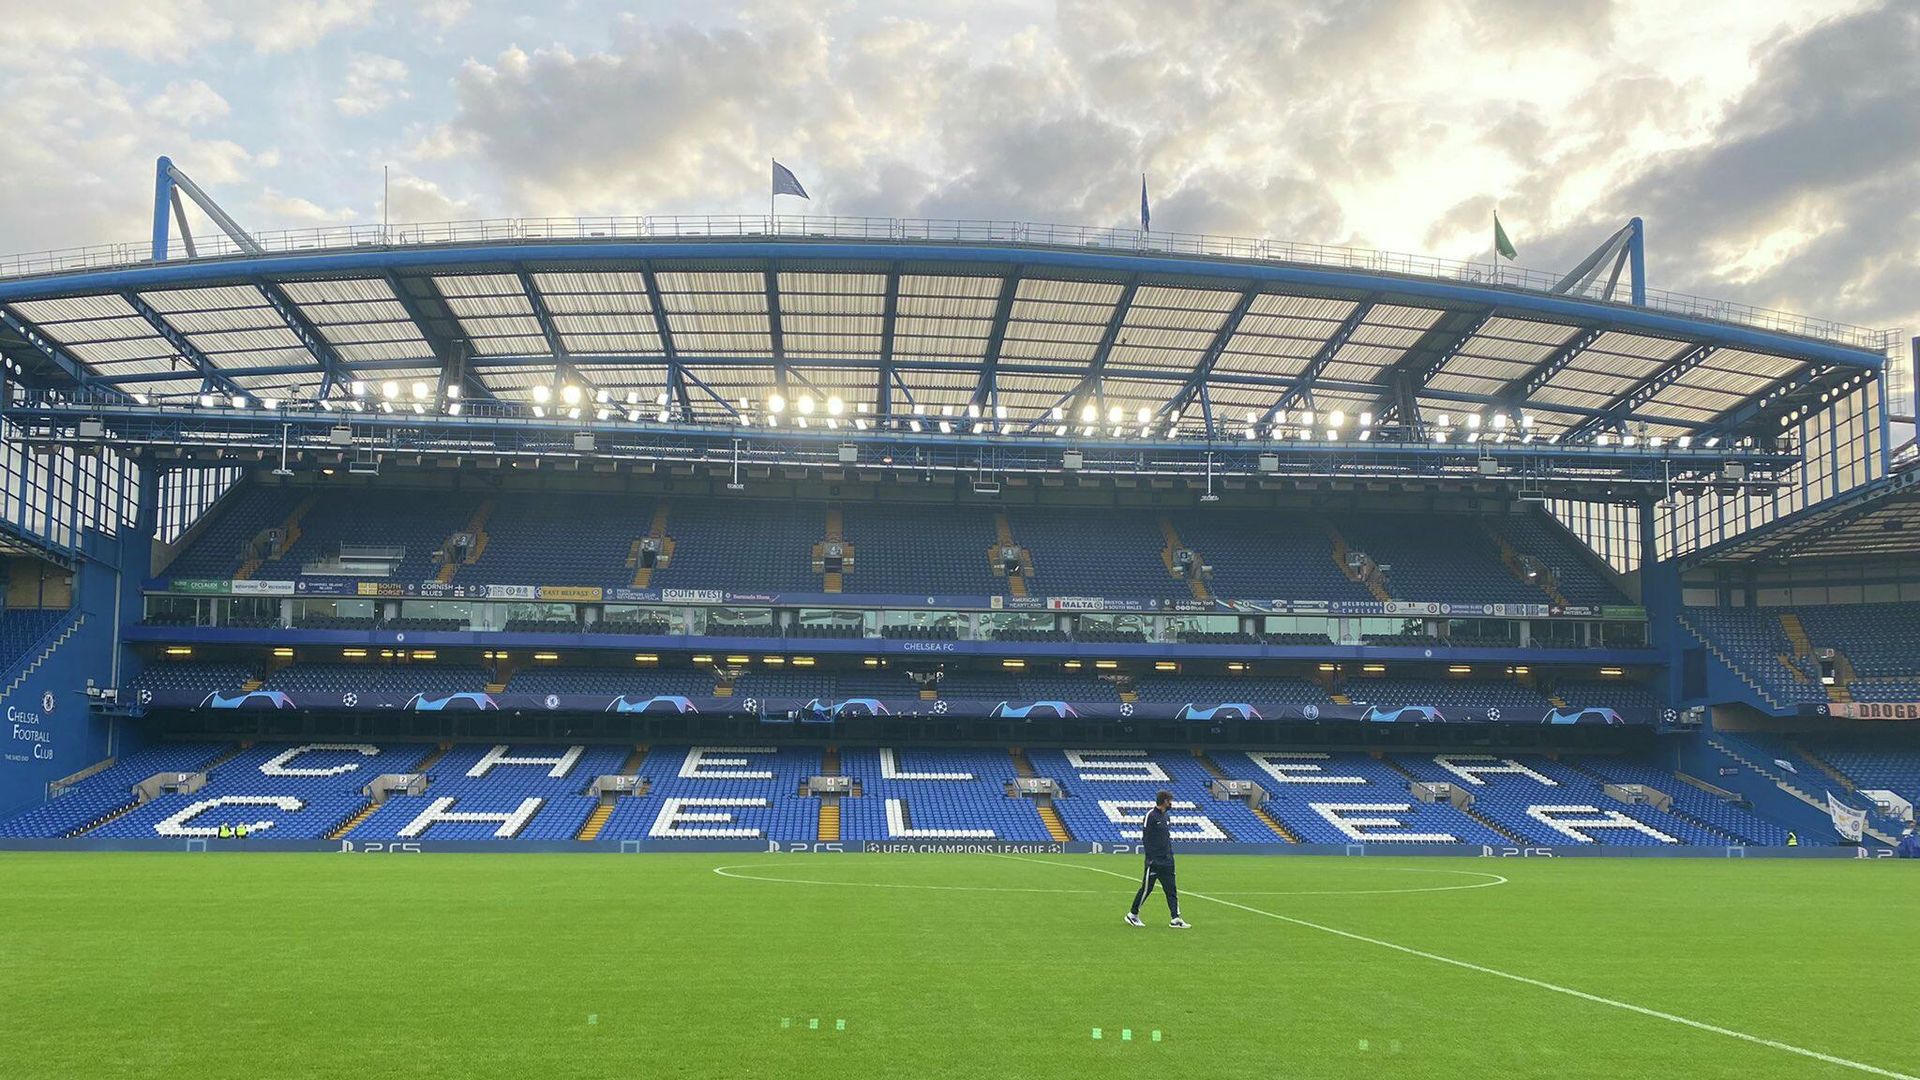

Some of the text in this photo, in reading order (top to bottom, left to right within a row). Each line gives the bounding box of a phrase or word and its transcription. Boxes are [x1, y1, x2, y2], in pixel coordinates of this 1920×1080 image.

[664, 589, 721, 598] SOUTH WEST
[904, 643, 941, 651] CHELSEA
[8, 706, 39, 724] CHELSEA
[1860, 704, 1917, 718] DROGB
[13, 724, 50, 742] FOOTBALL
[34, 744, 54, 759] CLUB
[883, 844, 1044, 854] UEFA CHAMPIONS LEAGUE
